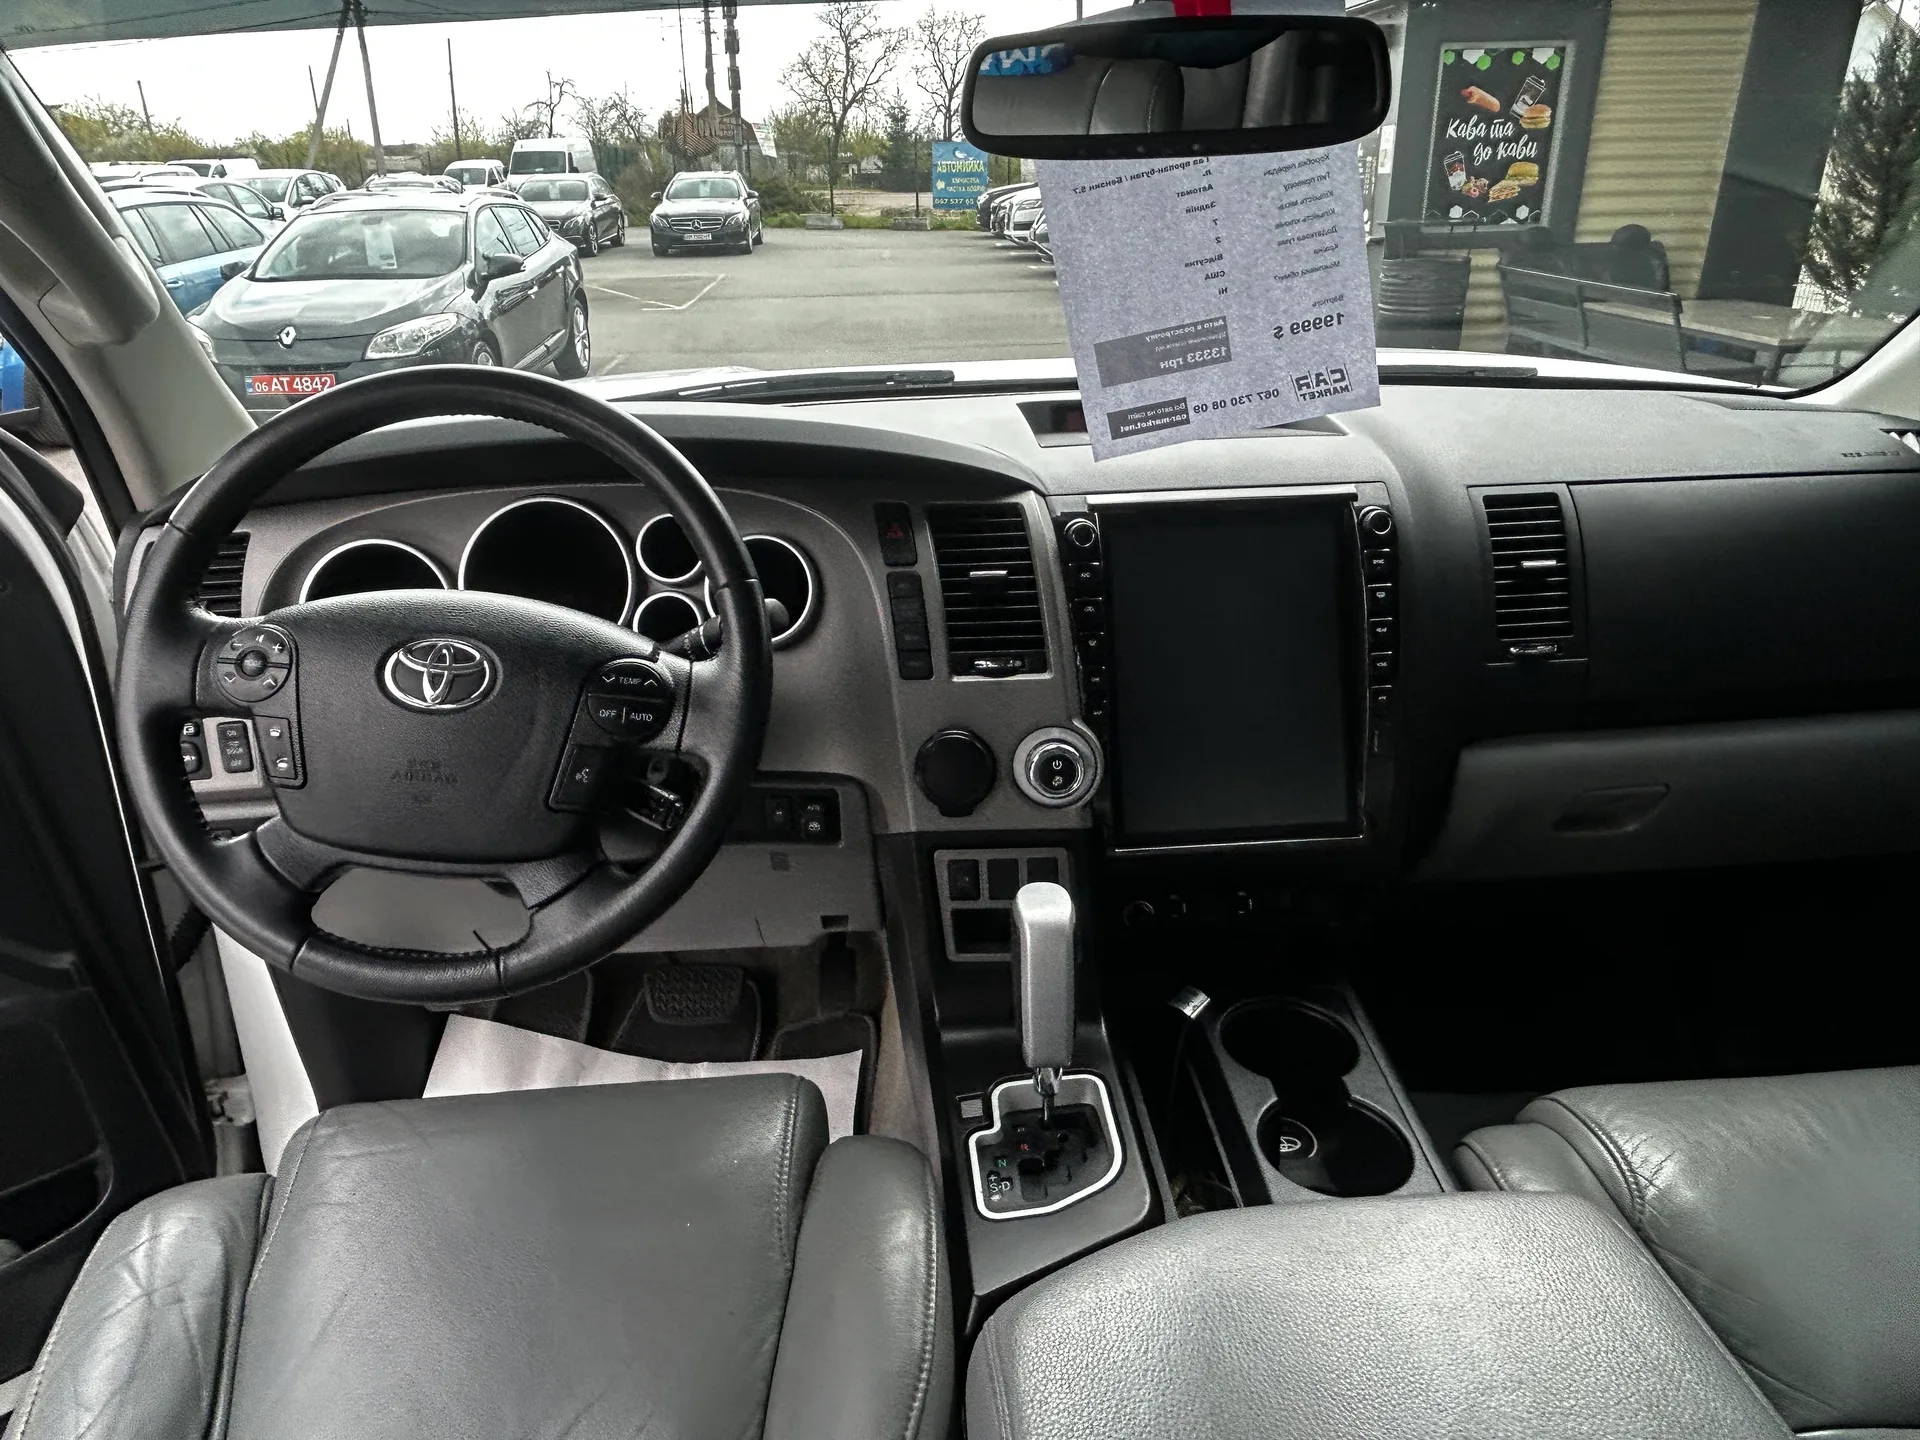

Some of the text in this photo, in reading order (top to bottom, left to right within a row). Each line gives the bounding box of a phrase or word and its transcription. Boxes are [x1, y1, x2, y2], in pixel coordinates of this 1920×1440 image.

[1446, 115, 1487, 140] Кава
[1473, 134, 1538, 166] до кави
[255, 376, 331, 392] 06 AT 4842
[599, 709, 653, 722] OFF AUTO
[1020, 1143, 1030, 1151] R
[997, 1159, 1007, 1167] N
